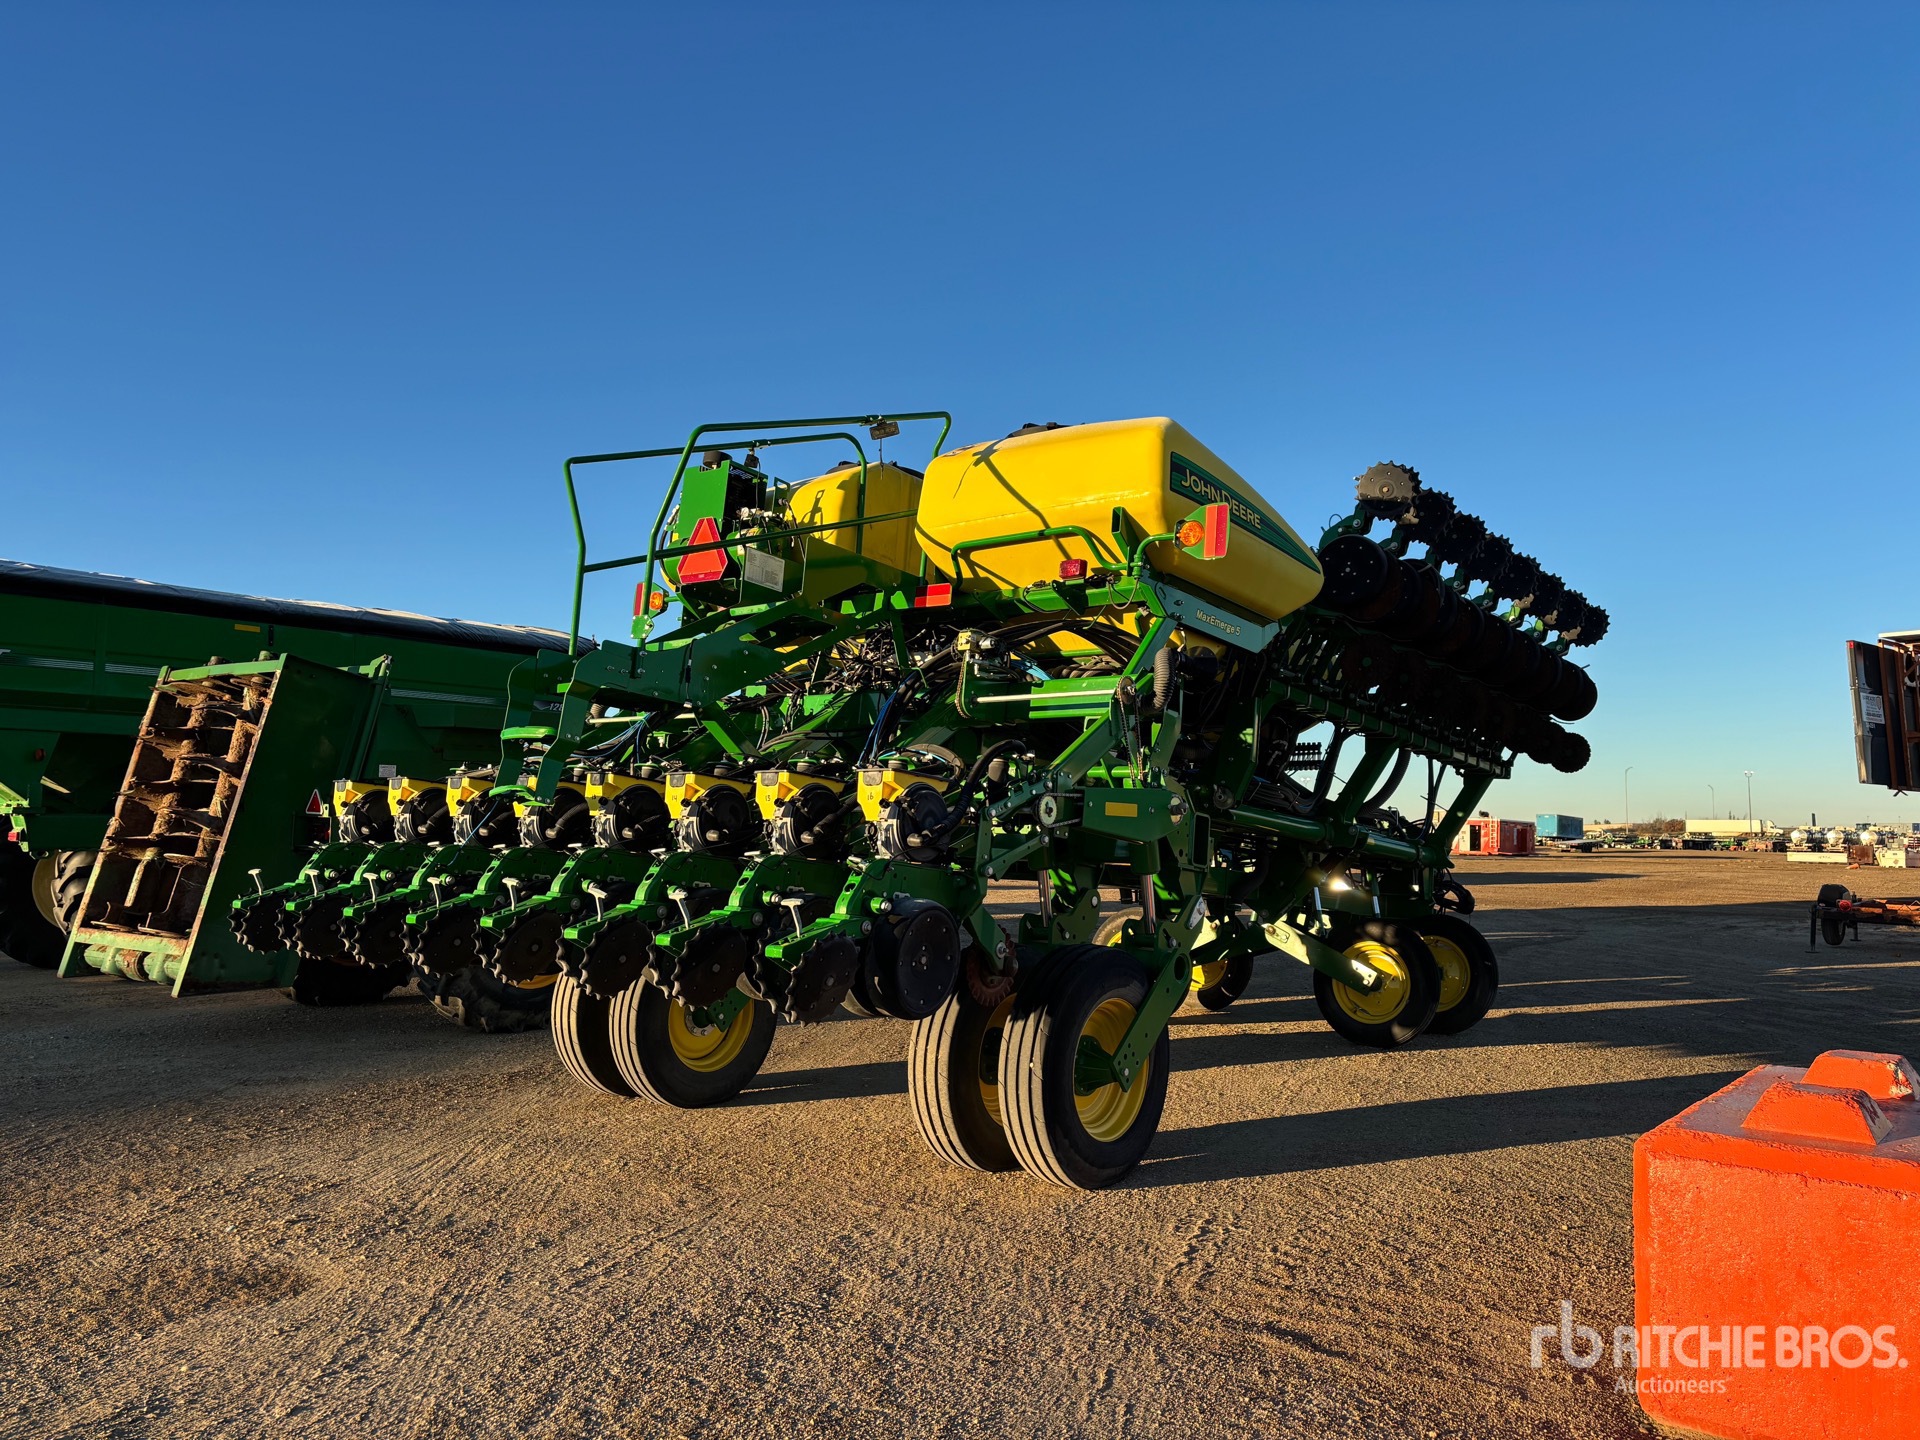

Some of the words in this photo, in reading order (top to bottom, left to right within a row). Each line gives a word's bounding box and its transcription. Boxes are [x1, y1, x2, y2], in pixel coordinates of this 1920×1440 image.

[1181, 468, 1221, 503] JOHN
[1222, 489, 1262, 530] DEERE
[1196, 609, 1235, 634] MaxEmerge
[1235, 626, 1241, 636] 5
